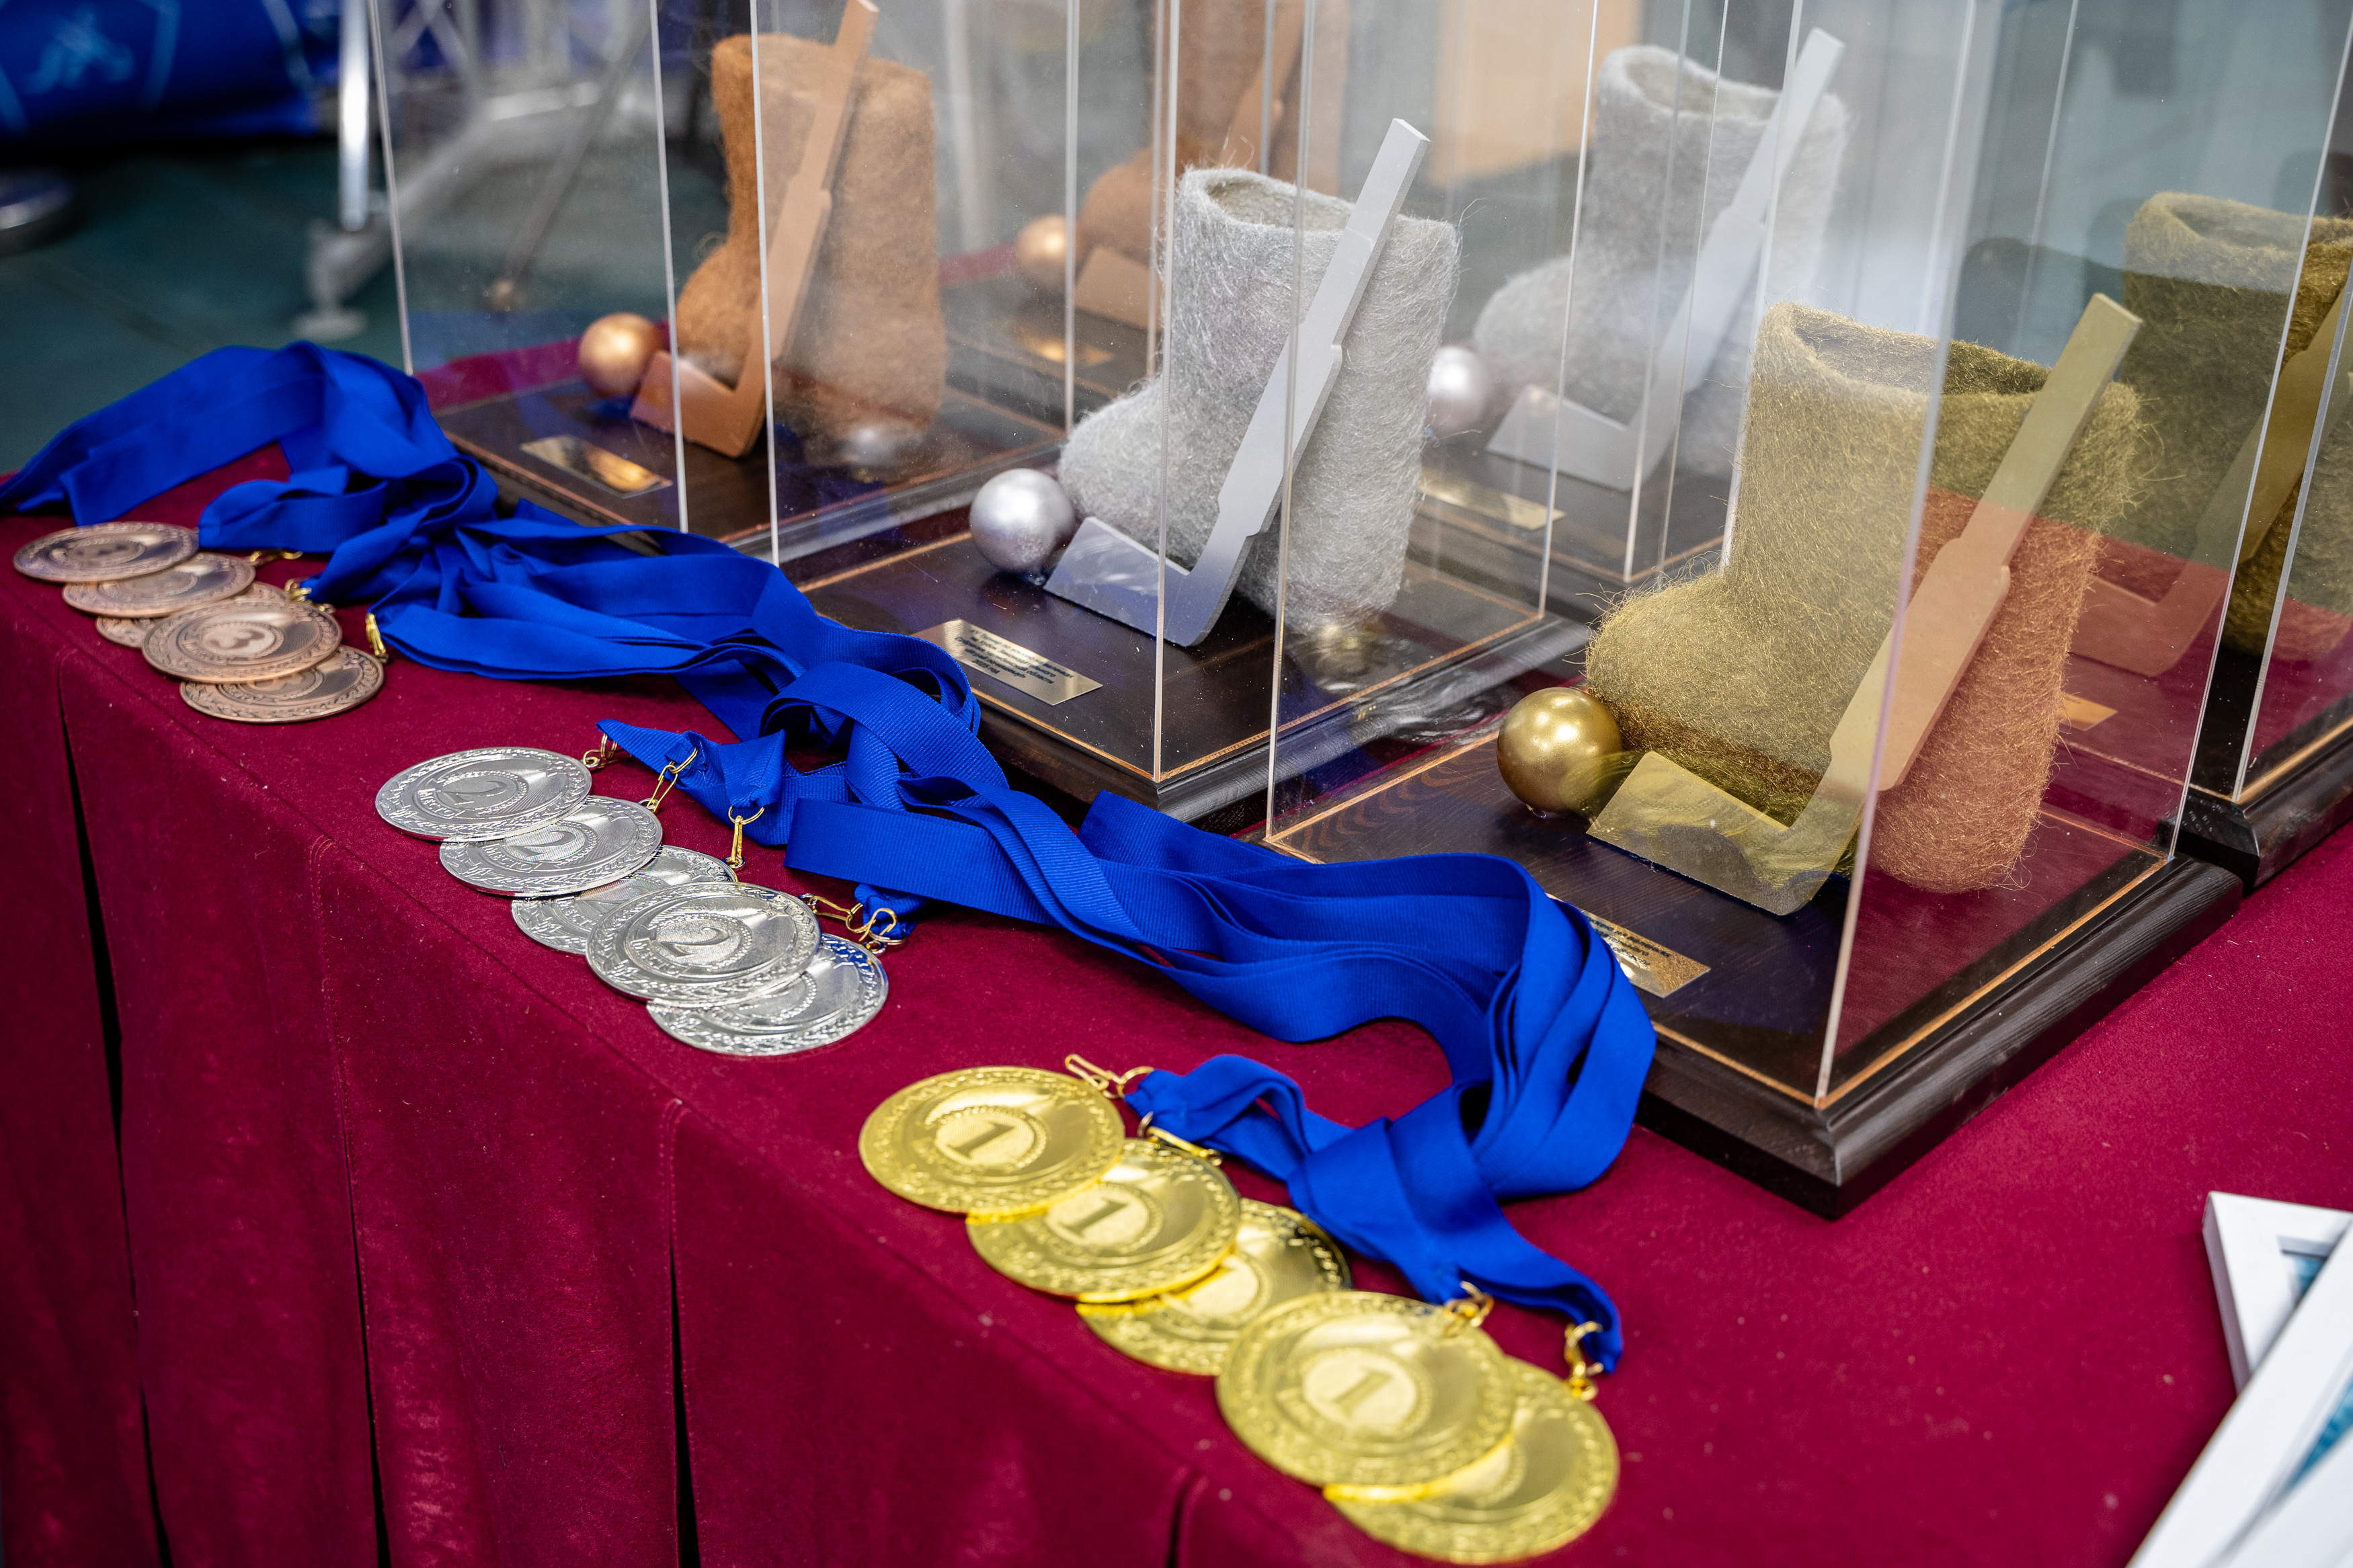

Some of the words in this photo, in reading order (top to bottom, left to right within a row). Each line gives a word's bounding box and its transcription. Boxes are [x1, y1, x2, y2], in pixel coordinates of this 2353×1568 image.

[210, 630, 265, 649] 3
[1027, 670, 1055, 684] области
[444, 780, 508, 805] 2
[510, 831, 575, 858] 2
[660, 927, 729, 958] 2
[947, 1122, 1014, 1158] 1
[1060, 1198, 1128, 1237] 1
[1325, 1368, 1393, 1417] 1
